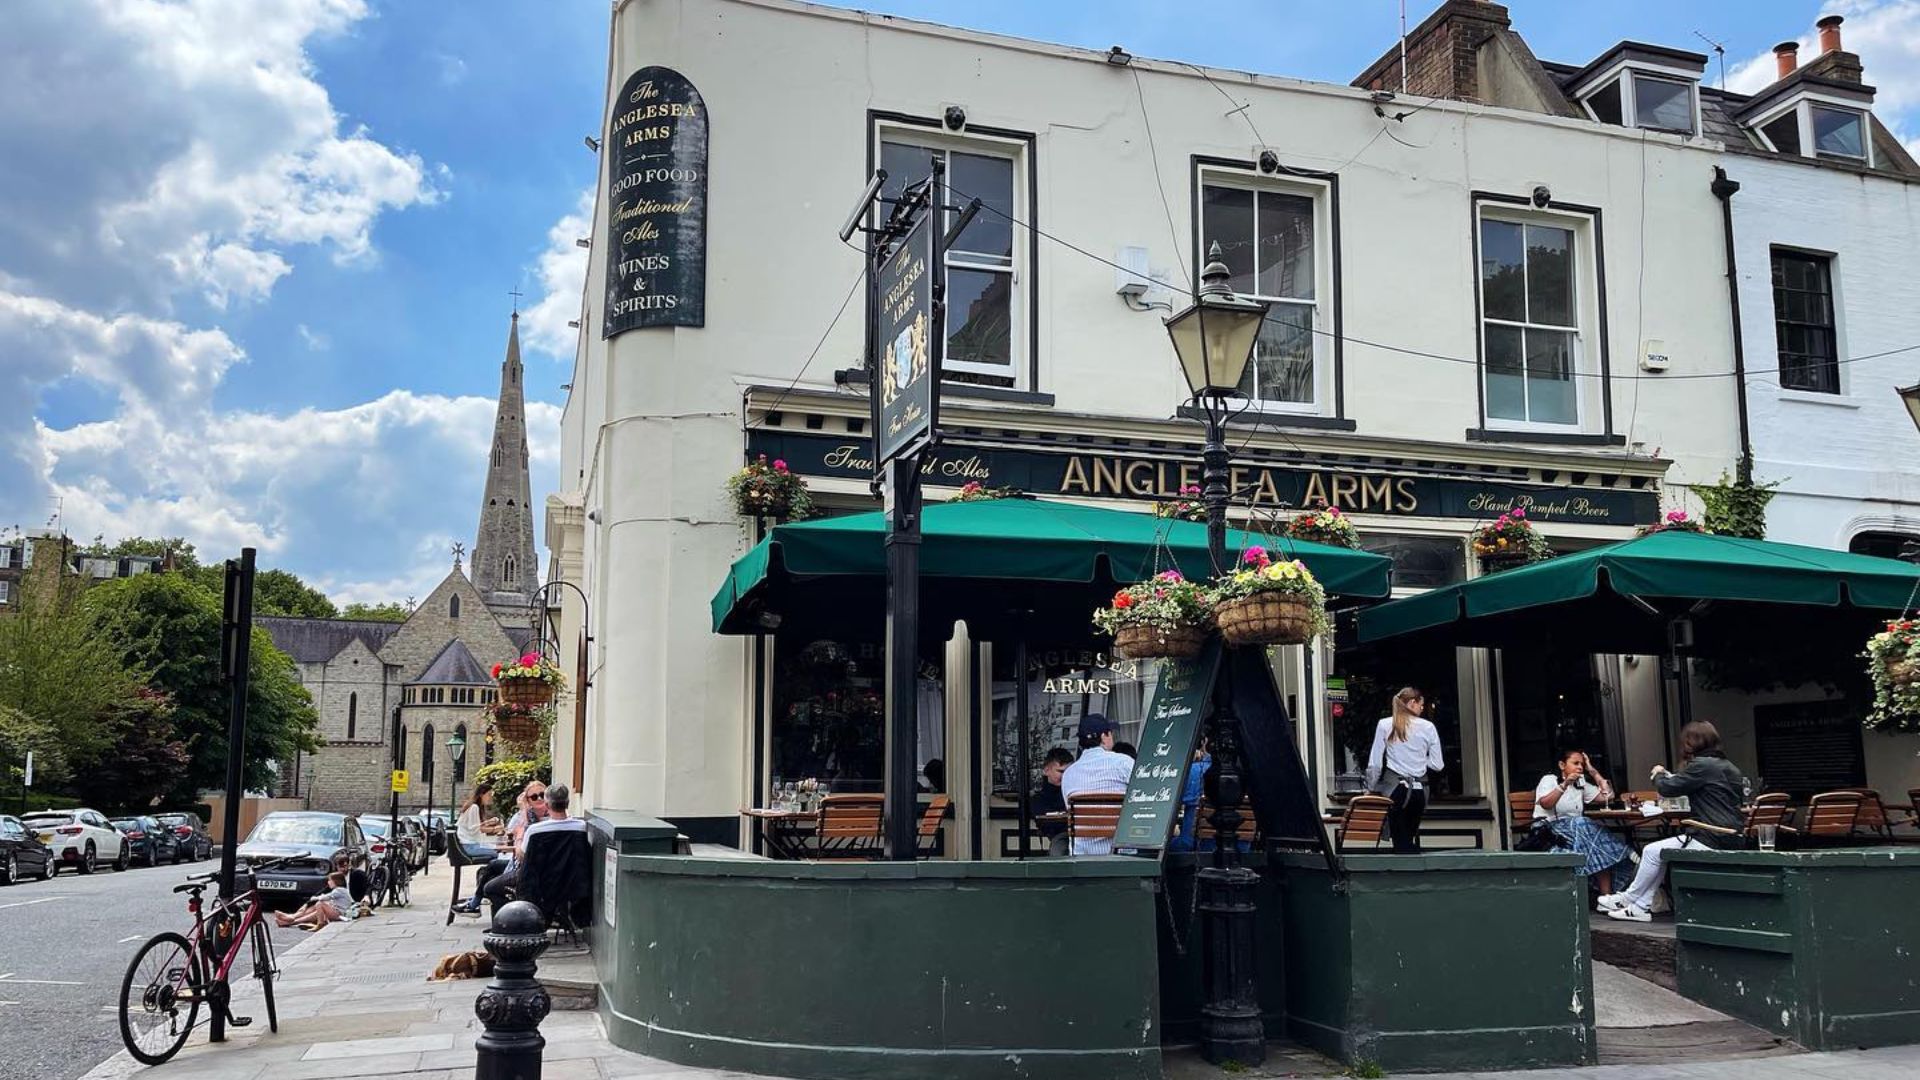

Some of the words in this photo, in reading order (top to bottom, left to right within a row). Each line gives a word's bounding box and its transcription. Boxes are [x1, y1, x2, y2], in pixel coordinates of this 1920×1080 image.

[630, 81, 659, 103] The
[612, 104, 696, 135] ANGLESEA
[624, 125, 670, 148] ARMS
[611, 171, 642, 197] GOOD
[646, 168, 697, 184] FOOD
[611, 197, 693, 228] Traditional
[622, 220, 660, 245] Ales
[618, 255, 670, 280] WINES
[633, 277, 647, 292] &
[883, 258, 925, 314] ANGLESEA
[613, 294, 677, 317] SPIRITS
[892, 291, 915, 326] ARMS
[942, 456, 990, 479] Ales
[1060, 456, 1281, 505] ANGLEEA
[1302, 473, 1417, 512] ARMS
[1468, 493, 1513, 512] Hand
[1516, 495, 1569, 518] Pumped
[1573, 497, 1609, 517] Beers
[1027, 650, 1138, 681] NGLESEA
[1043, 678, 1111, 695] ARMS
